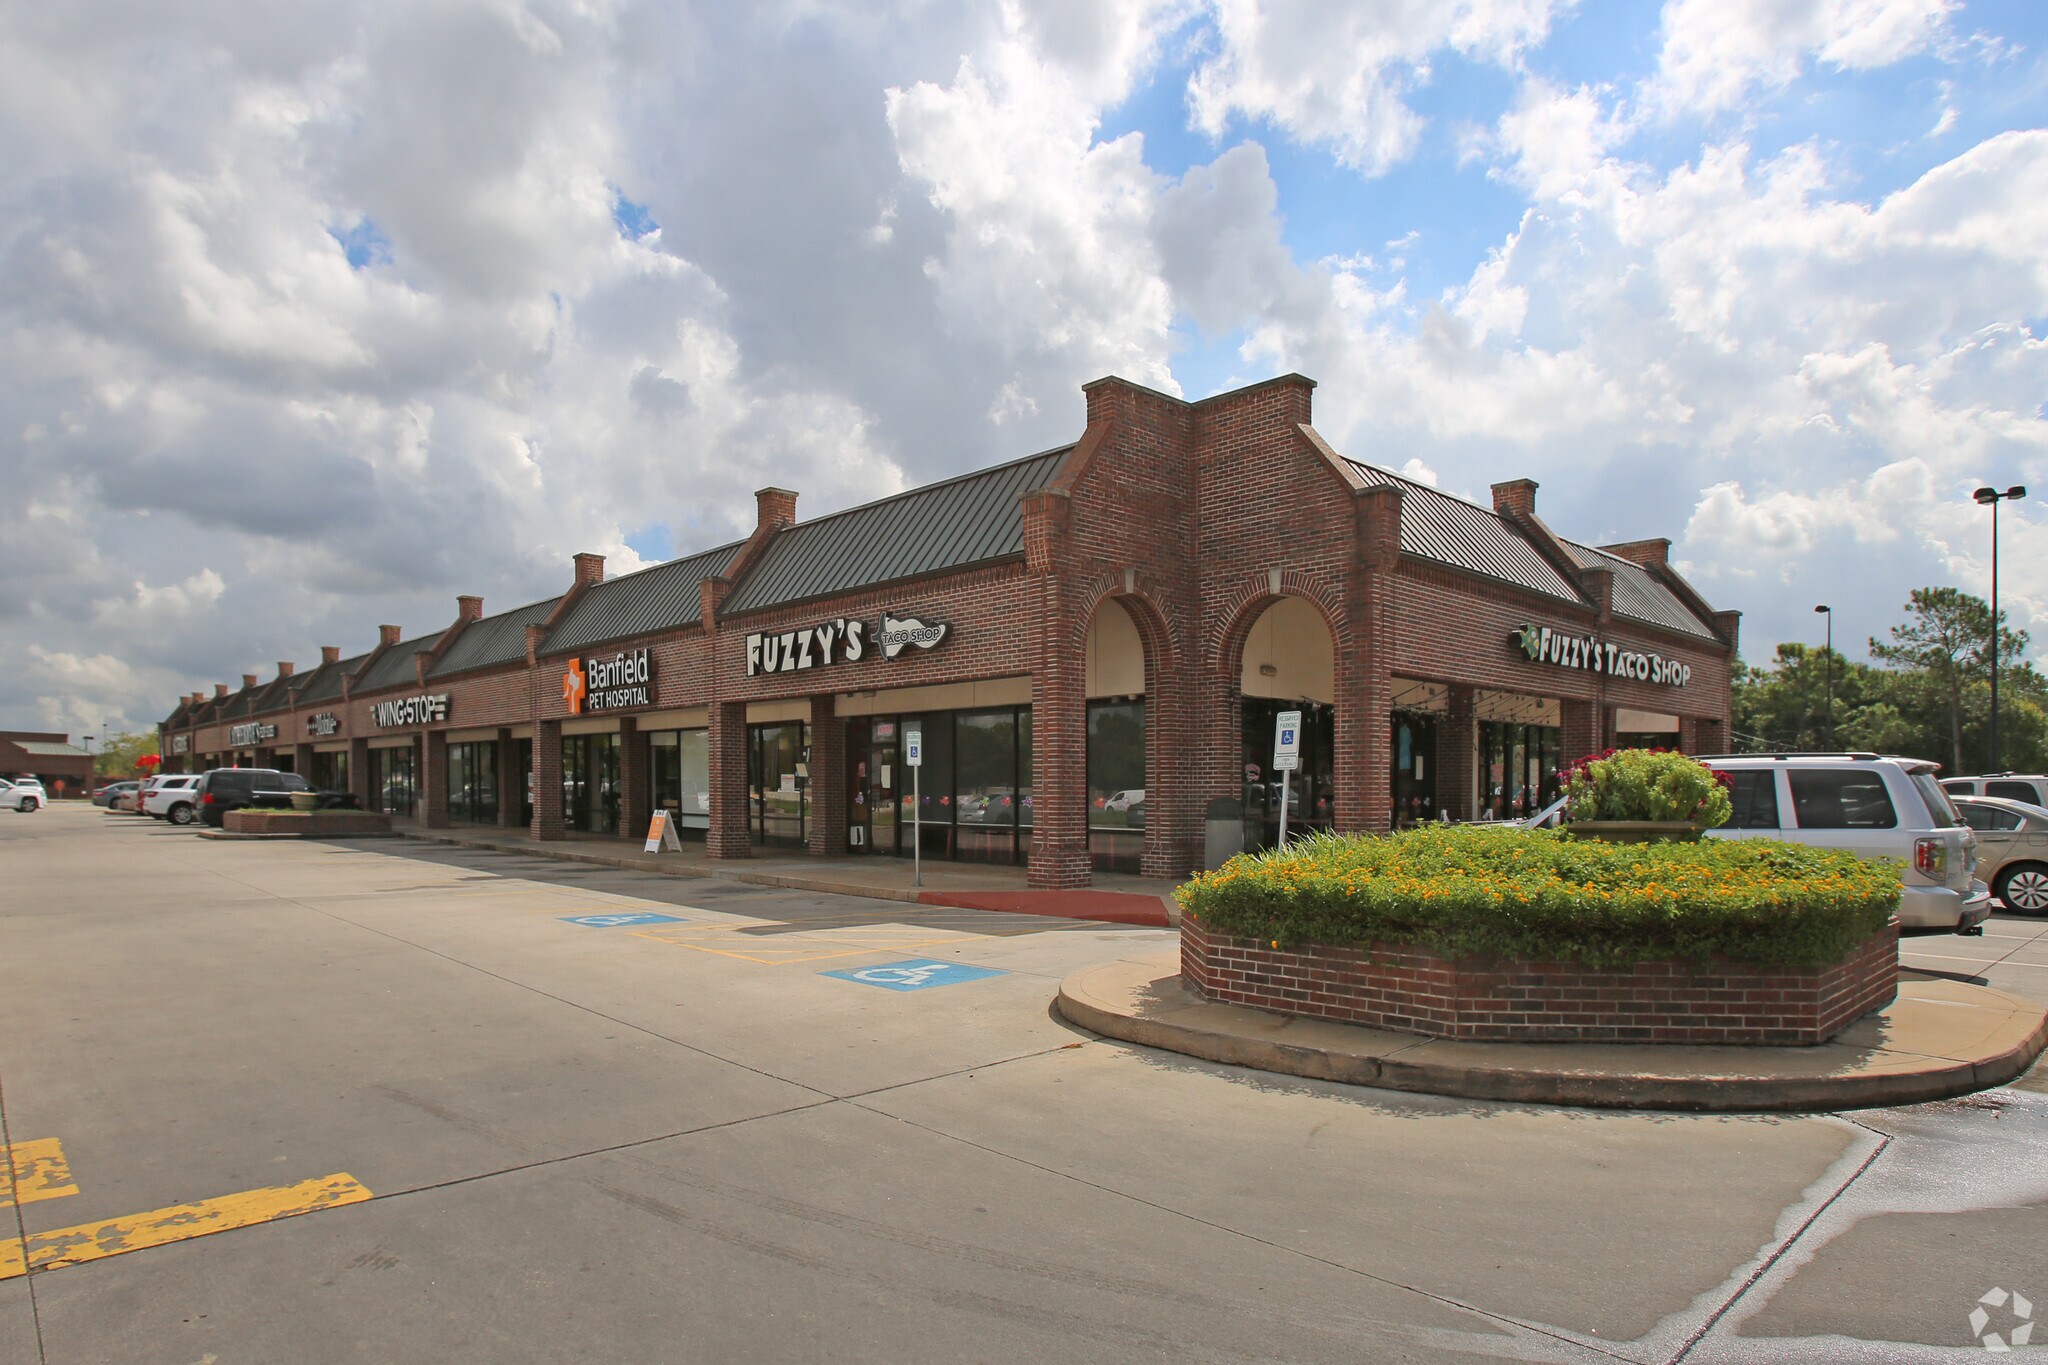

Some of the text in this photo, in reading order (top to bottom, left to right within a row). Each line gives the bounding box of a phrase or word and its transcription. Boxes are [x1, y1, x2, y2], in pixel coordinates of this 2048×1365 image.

[746, 618, 863, 677] FUZZY'S
[882, 626, 941, 646] TACO SHOP
[1539, 627, 1691, 687] FUZZY'S TACO SHOP
[588, 648, 649, 690] Banfield
[589, 687, 649, 709] PET HOSPITAL
